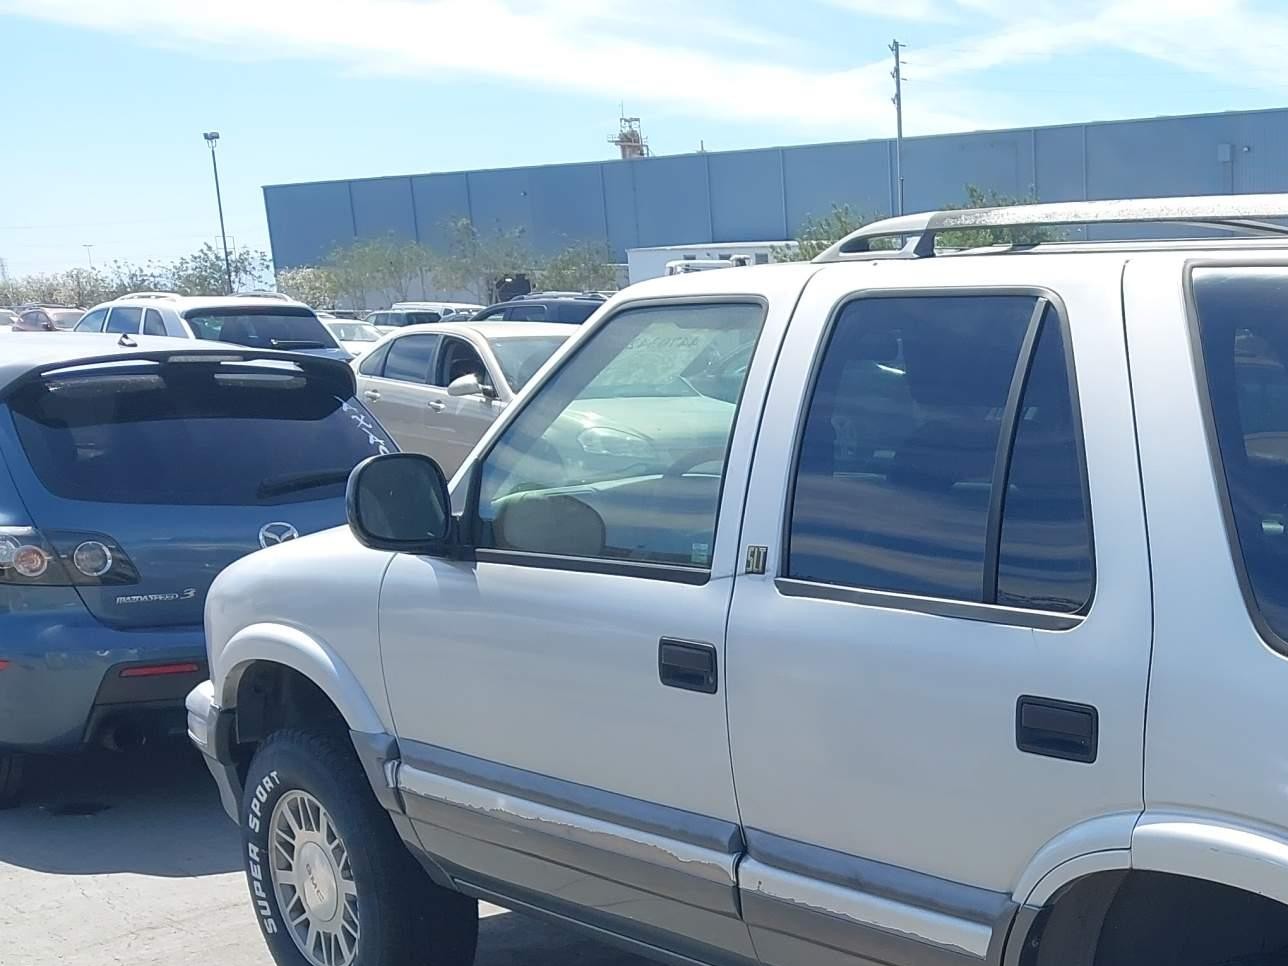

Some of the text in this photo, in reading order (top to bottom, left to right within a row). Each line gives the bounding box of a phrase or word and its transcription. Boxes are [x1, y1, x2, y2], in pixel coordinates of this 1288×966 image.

[746, 547, 767, 572] SLT
[180, 587, 197, 600] 3
[247, 770, 281, 935] SUPER SPORT
[305, 863, 326, 903] GMC
